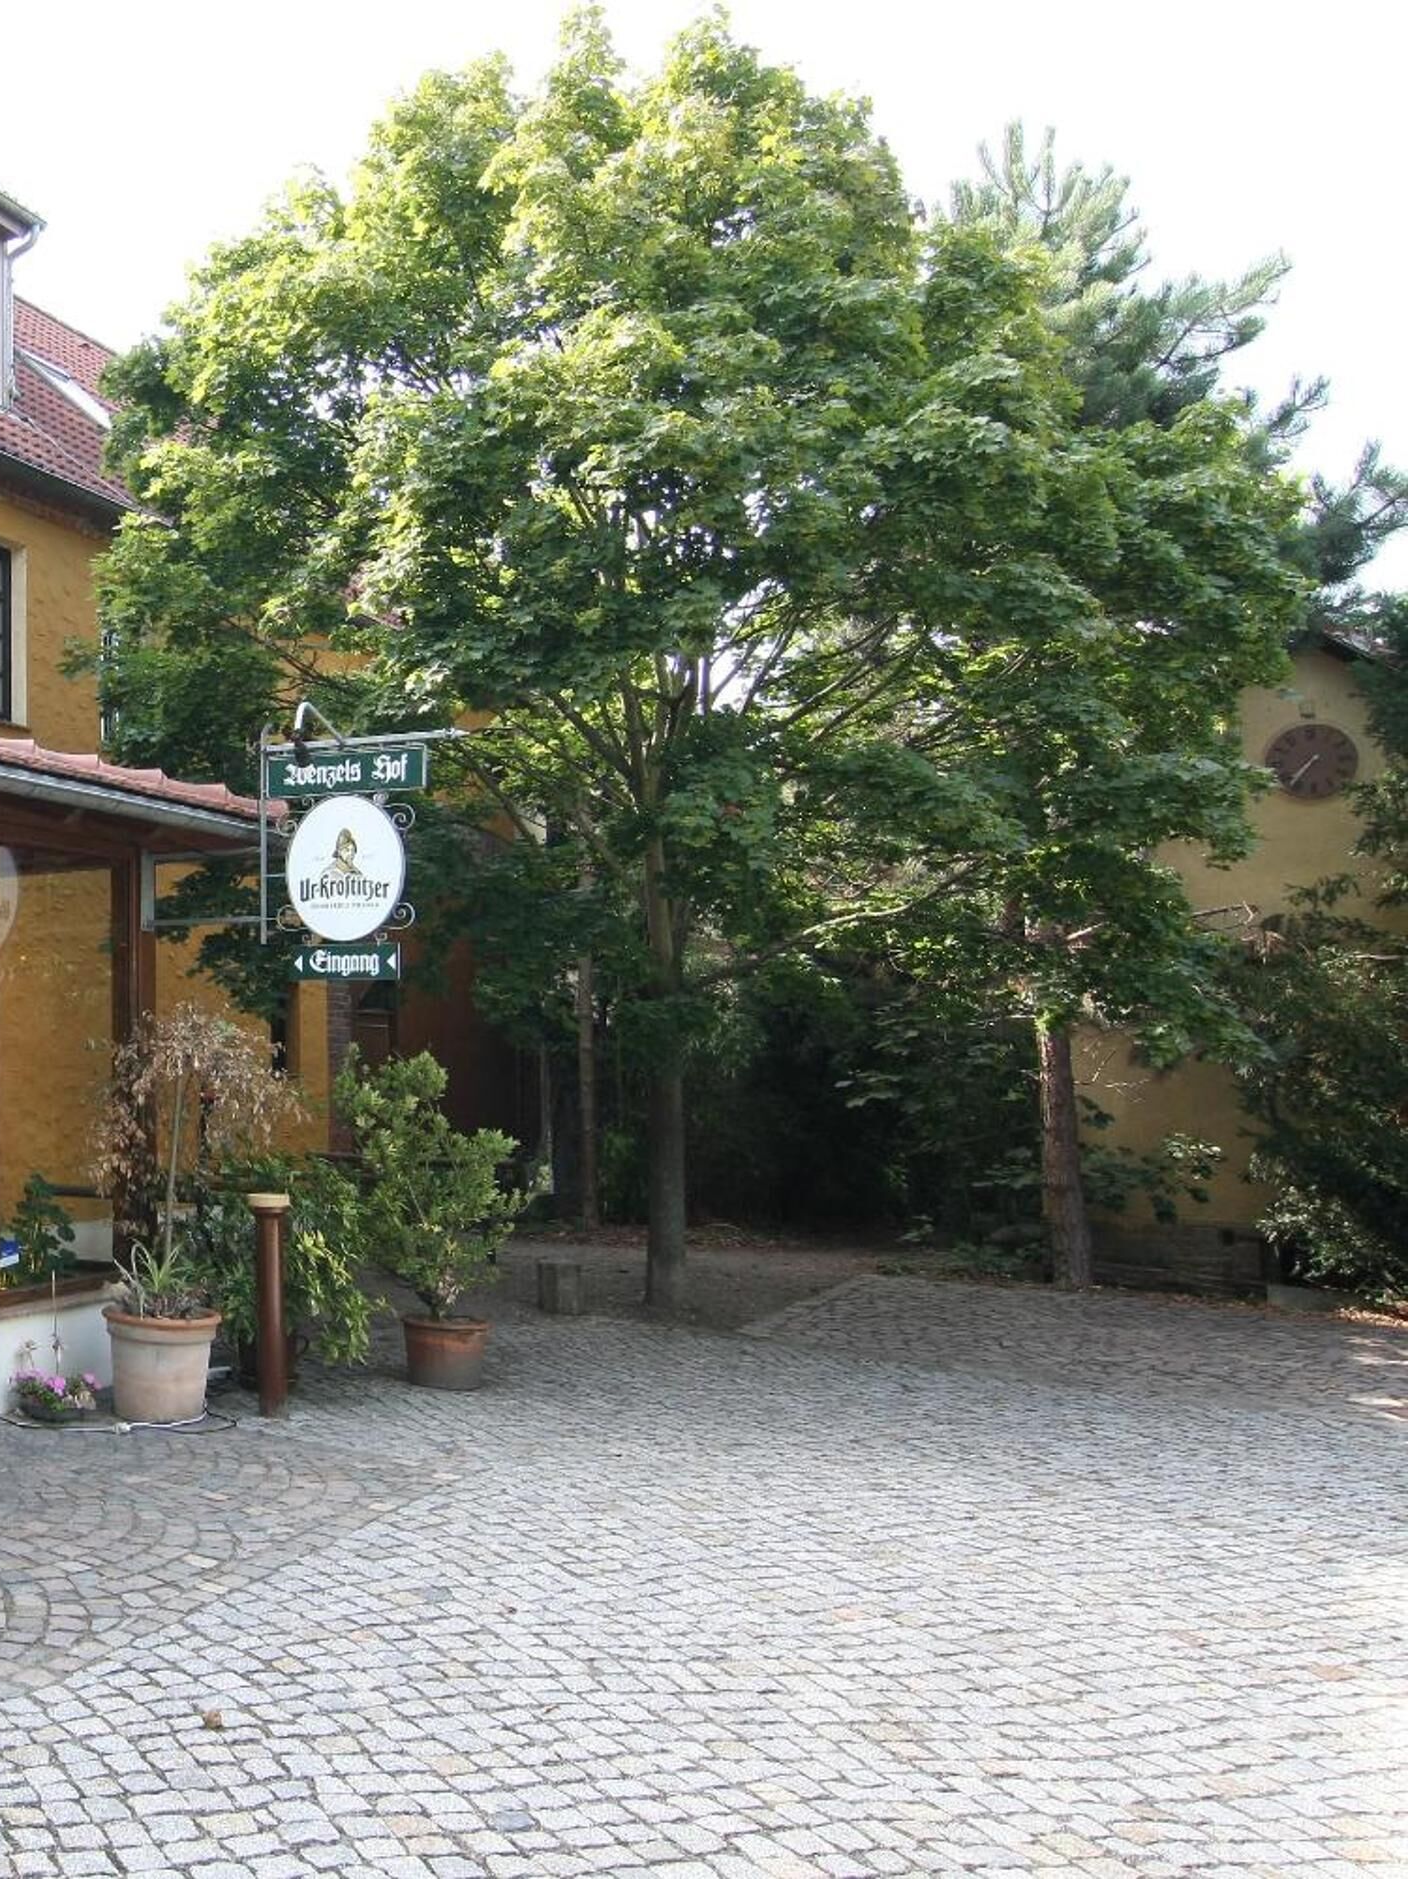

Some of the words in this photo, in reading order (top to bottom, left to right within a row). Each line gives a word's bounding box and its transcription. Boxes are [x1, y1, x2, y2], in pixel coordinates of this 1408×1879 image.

[283, 759, 361, 788] Wenzels
[371, 753, 408, 783] Hof
[309, 949, 380, 977] Eingang
